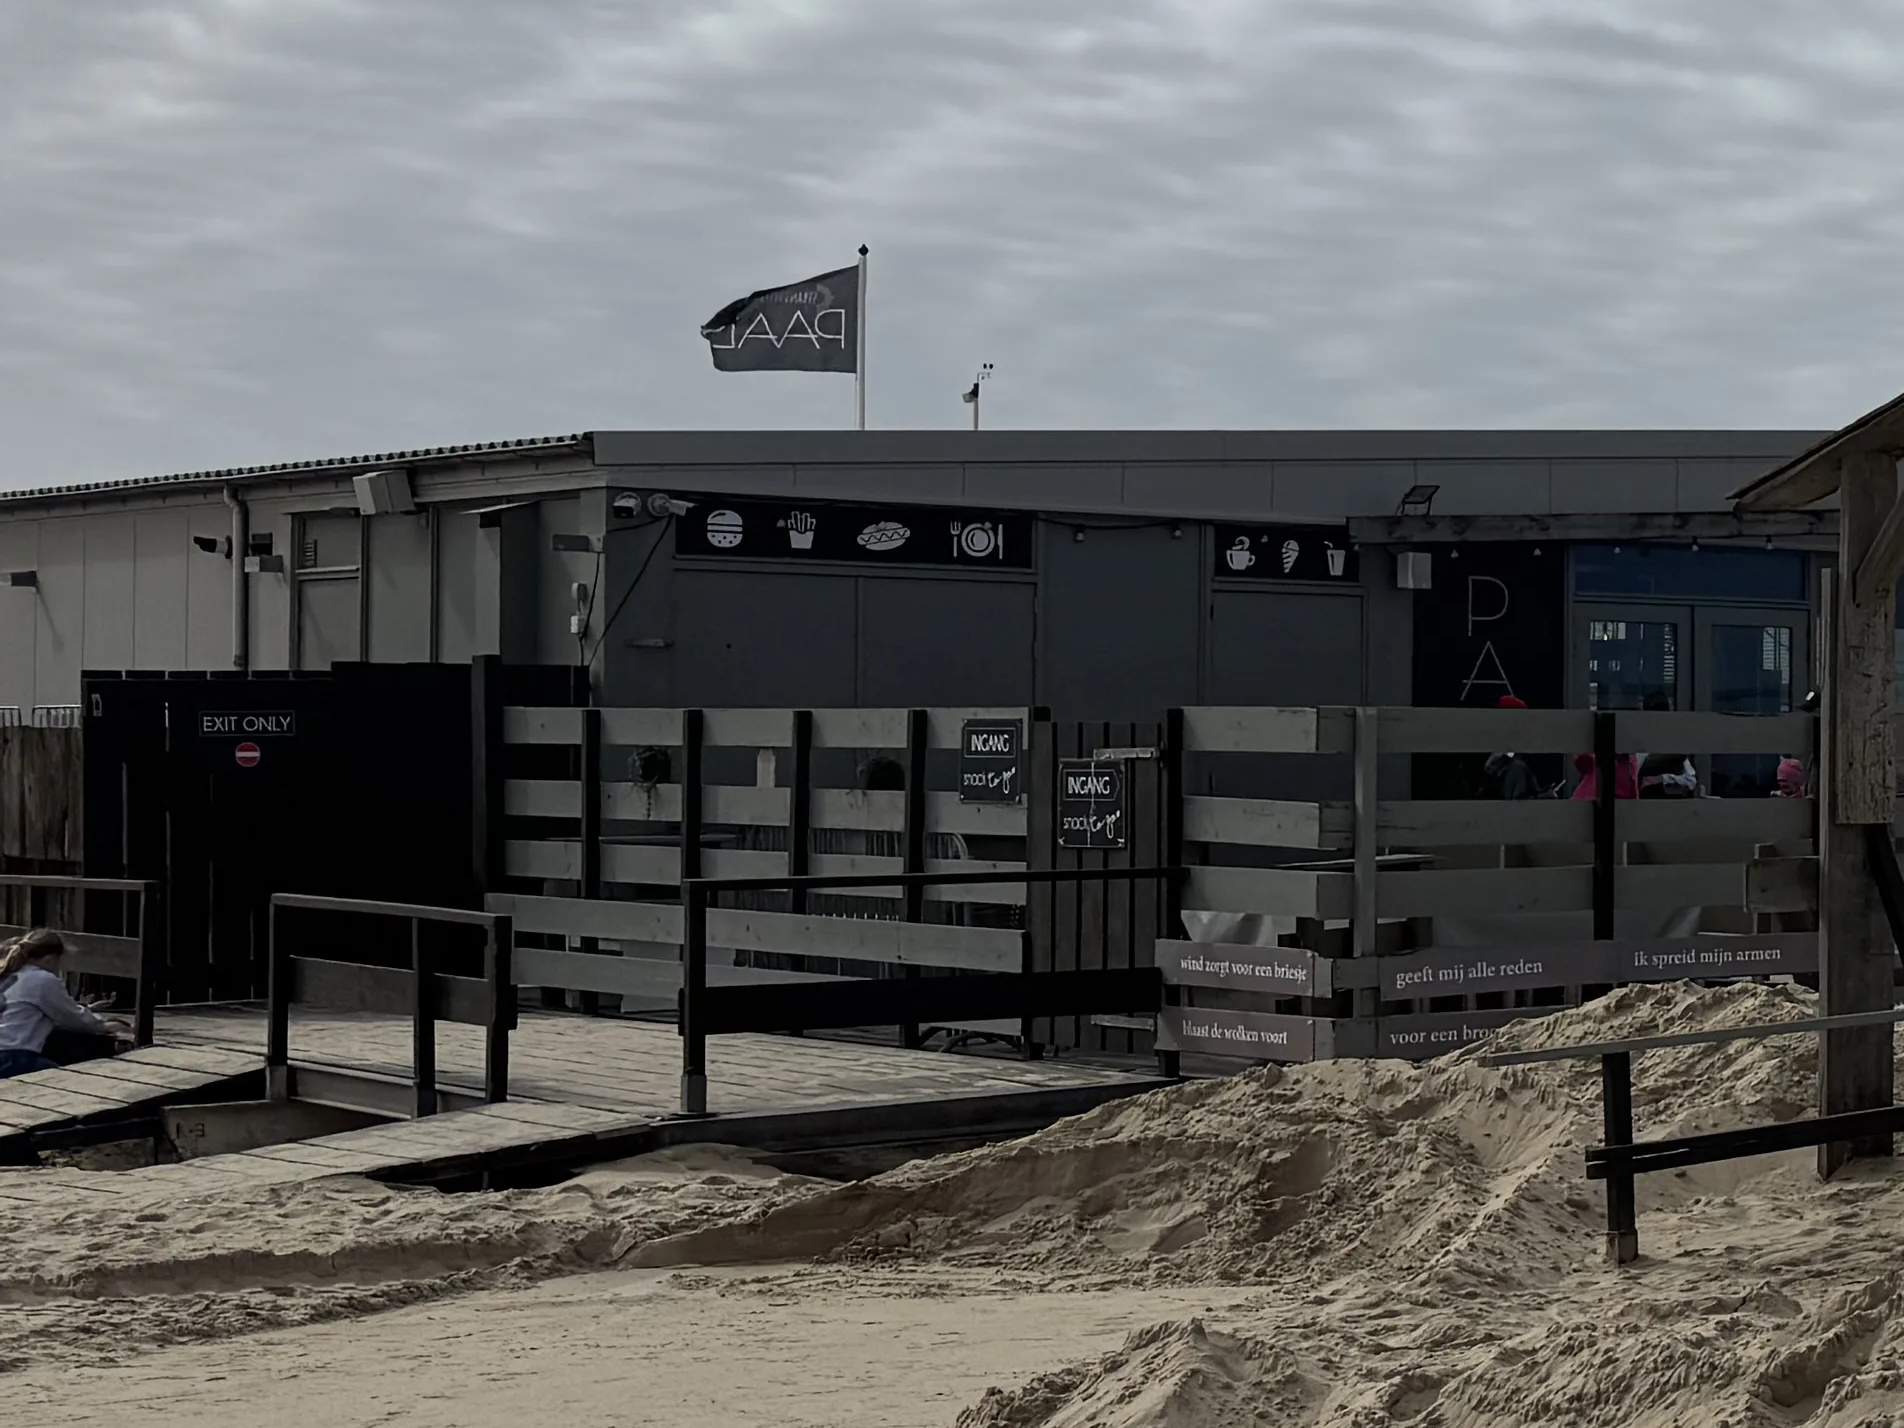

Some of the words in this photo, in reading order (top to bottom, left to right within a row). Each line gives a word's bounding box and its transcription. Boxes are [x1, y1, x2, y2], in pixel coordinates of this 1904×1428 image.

[202, 715, 239, 733] EXIT
[242, 715, 291, 733] ONLY
[971, 733, 1010, 753] INGANG
[1067, 775, 1111, 795] INGANG
[1634, 951, 1649, 967] ik
[1651, 948, 1696, 969] spreid
[1699, 948, 1733, 966] mijn
[1736, 948, 1781, 962] armen
[1180, 956, 1204, 972] wind
[1205, 960, 1230, 978] zorgt
[1231, 963, 1253, 976] voor
[1255, 965, 1272, 978] een
[1274, 961, 1308, 984] briesje
[1396, 965, 1433, 988] geeft
[1438, 963, 1464, 985] mij
[1467, 961, 1495, 979] alle
[1499, 959, 1542, 977] reden
[1181, 1019, 1209, 1039] blaast
[1210, 1021, 1223, 1039] de
[1224, 1025, 1259, 1042] wolken
[1261, 1030, 1288, 1045] voort
[1390, 1030, 1426, 1045] voor
[1430, 1027, 1458, 1042] een
